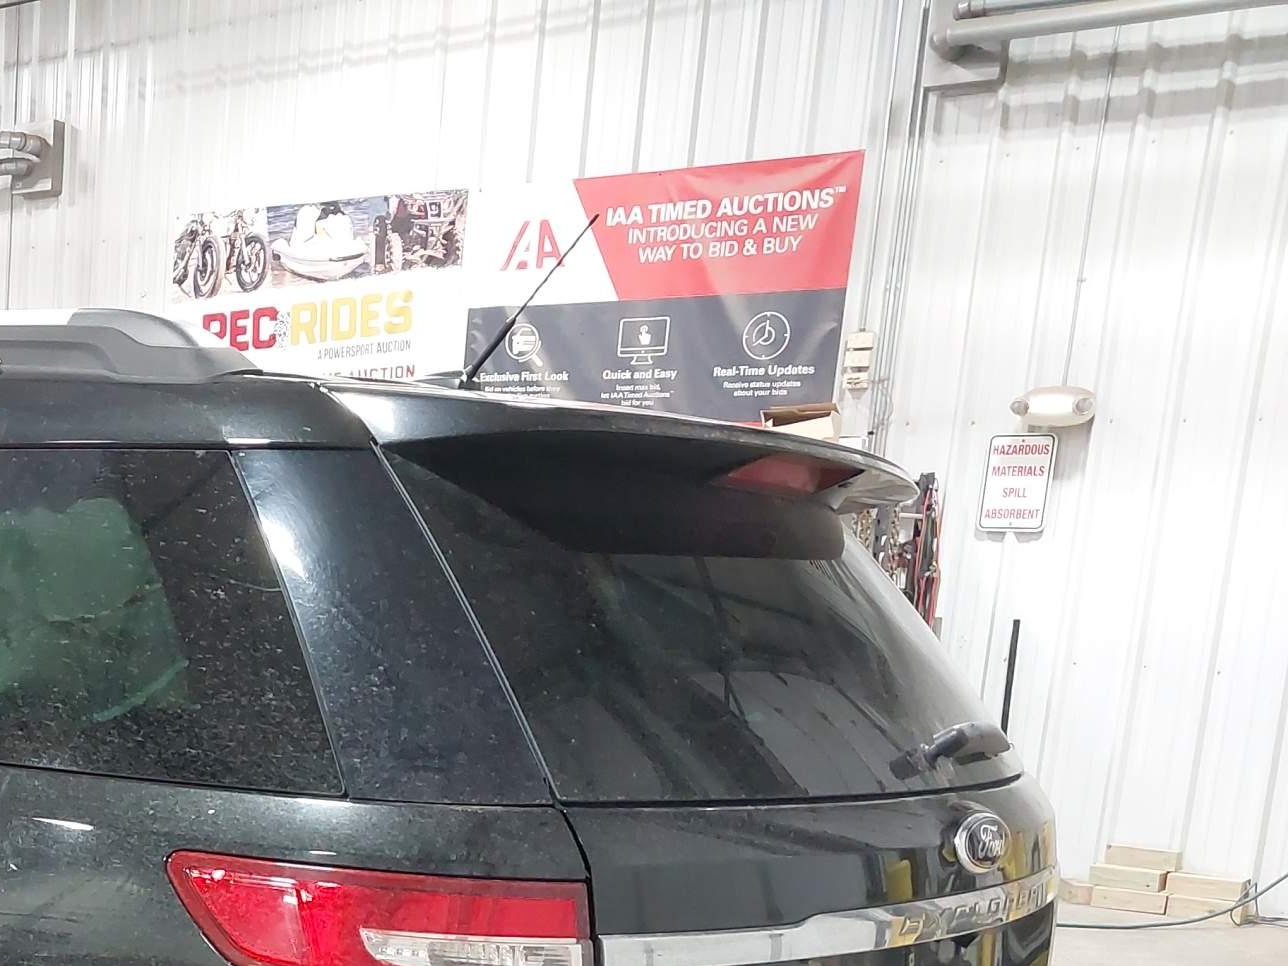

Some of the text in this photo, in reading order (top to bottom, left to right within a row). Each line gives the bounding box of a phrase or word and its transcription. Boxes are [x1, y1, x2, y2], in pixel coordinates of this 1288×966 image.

[606, 205, 643, 227] IAA
[648, 200, 712, 224] TIMED
[628, 213, 819, 245] INTRODUCING A NEW
[638, 235, 803, 264] WAY TO BID & BUY
[289, 290, 414, 347] RIDES
[324, 342, 375, 360] POWERSPORT
[376, 339, 411, 355] AUCTION
[480, 371, 569, 382] Exclusive First Look
[602, 368, 678, 380] Quick and Easy
[713, 365, 816, 377] Real-Time Updates
[771, 380, 801, 388] updates
[992, 444, 1050, 456] HAZARDOUS
[991, 465, 1046, 477] MATERIALS
[1002, 487, 1028, 498] SPILL
[984, 508, 1041, 520] ABSORBENT
[977, 824, 1006, 858] Ford
